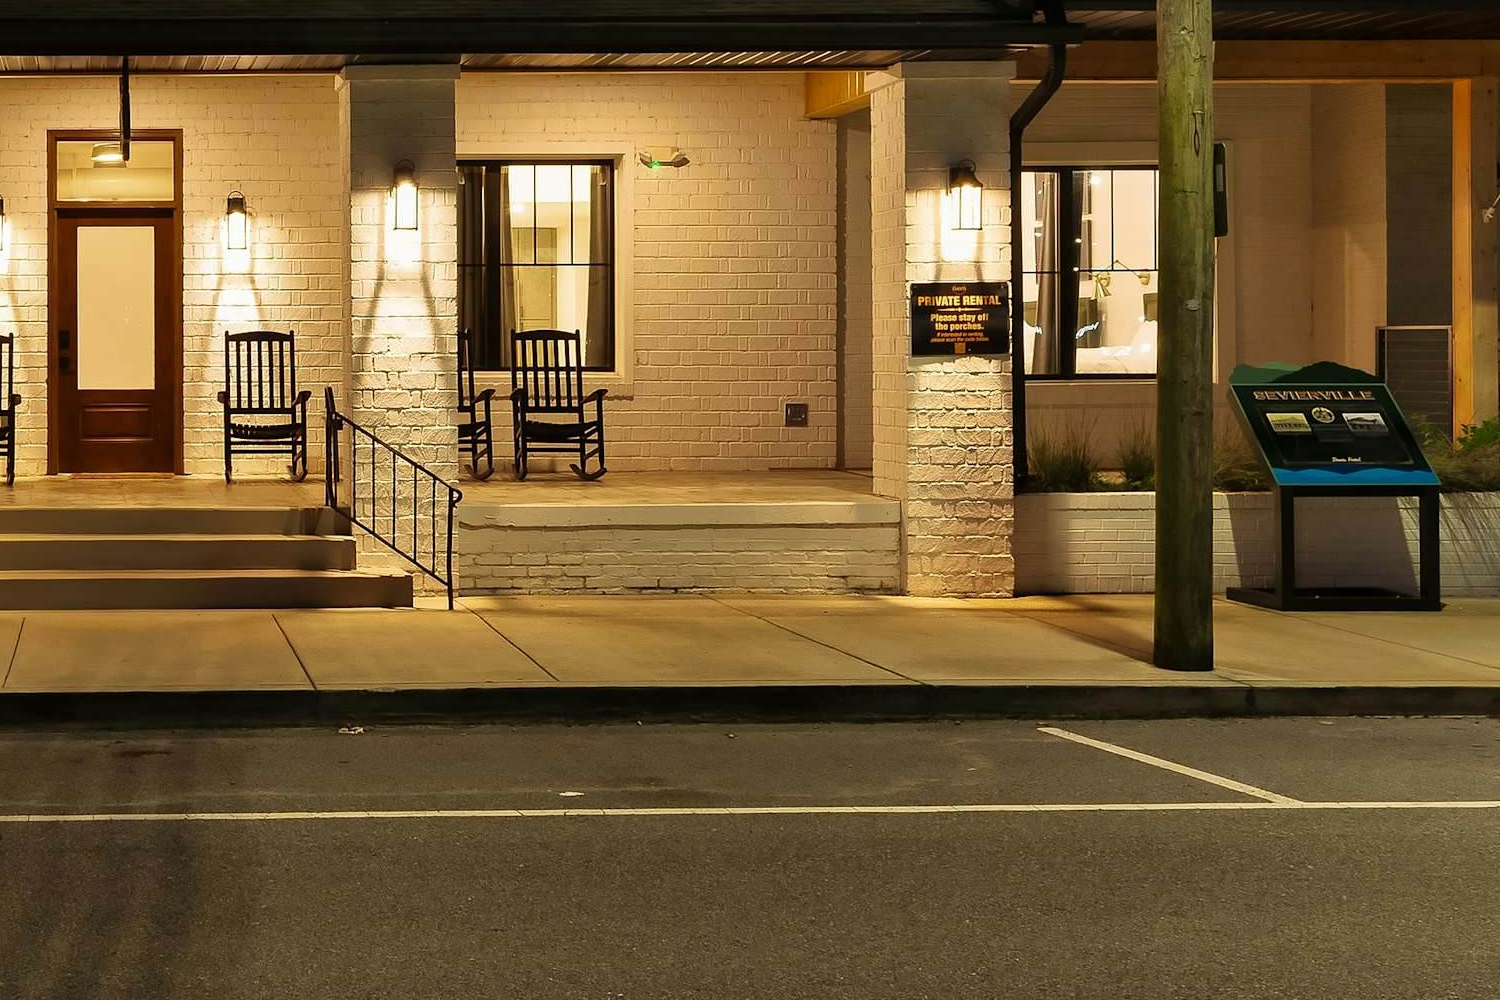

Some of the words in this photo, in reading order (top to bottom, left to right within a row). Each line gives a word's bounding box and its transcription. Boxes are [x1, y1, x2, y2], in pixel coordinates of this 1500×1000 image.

[917, 295, 960, 306] PRIVATE
[962, 295, 1001, 306] RENTAL
[930, 313, 958, 322] Please
[958, 313, 976, 323] stay
[977, 312, 989, 321] off
[935, 322, 949, 330] the
[950, 322, 984, 332] porches.
[1252, 390, 1376, 401] SEVIERVILLE
